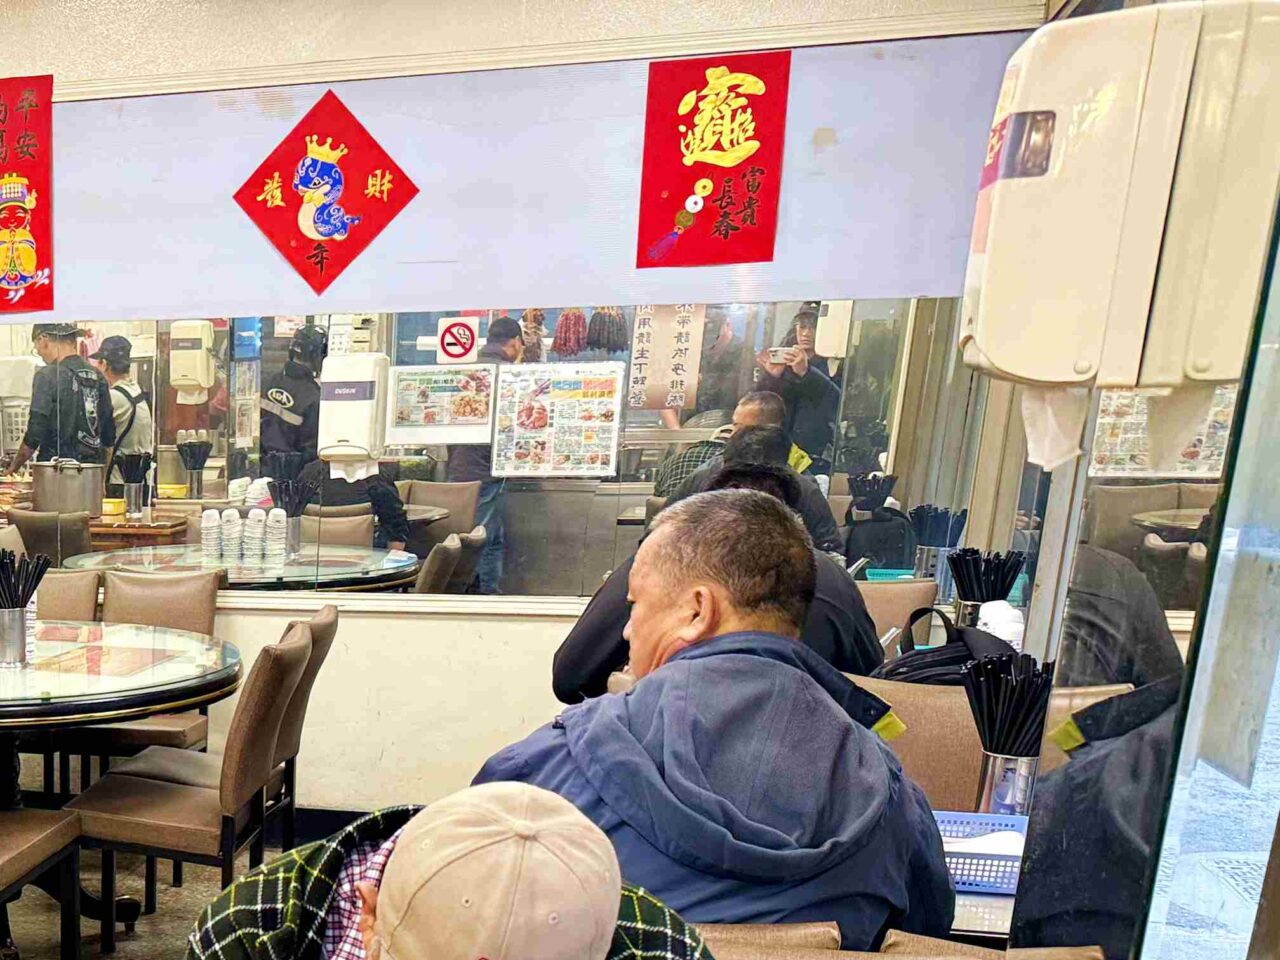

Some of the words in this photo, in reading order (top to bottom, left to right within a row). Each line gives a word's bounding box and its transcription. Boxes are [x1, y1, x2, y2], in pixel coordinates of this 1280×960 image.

[13, 88, 40, 161] 平安
[255, 170, 287, 209] 發
[363, 168, 395, 203] 財
[710, 177, 741, 241] 長春
[735, 166, 767, 227] 富貴
[305, 242, 330, 276] 年
